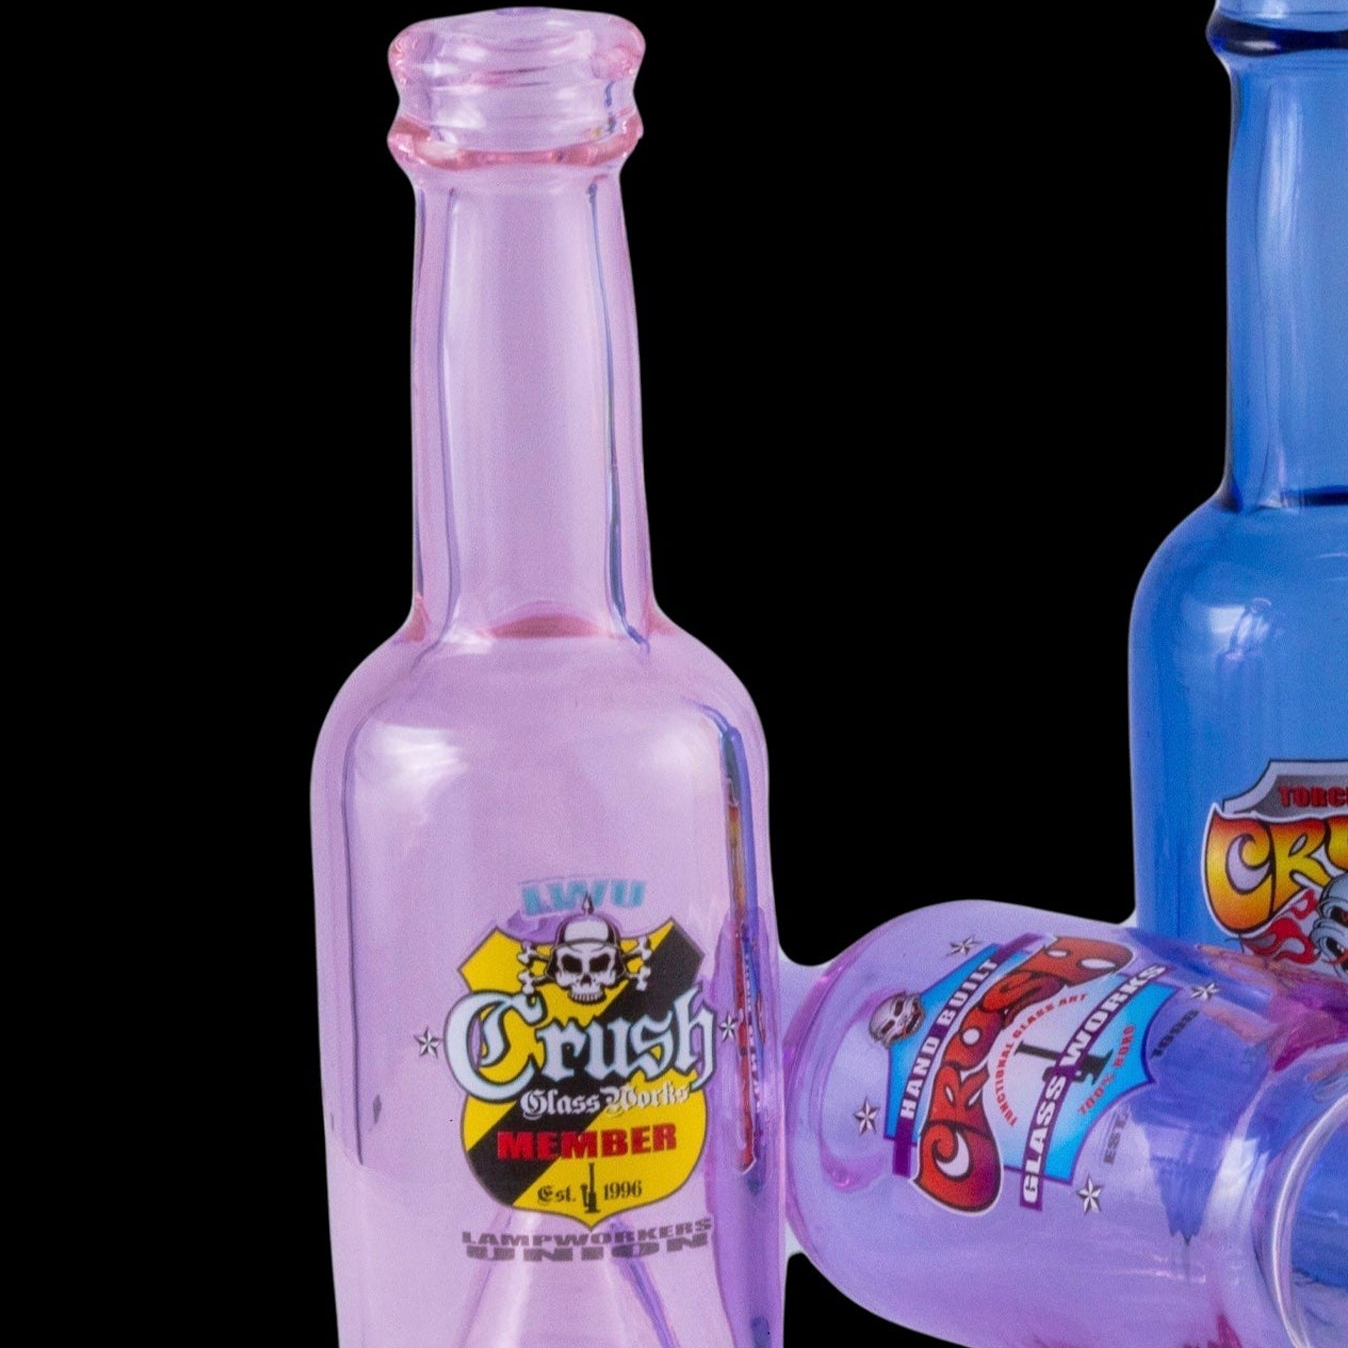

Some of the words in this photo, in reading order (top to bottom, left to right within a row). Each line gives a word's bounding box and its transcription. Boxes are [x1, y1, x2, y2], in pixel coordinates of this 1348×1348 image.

[443, 981, 718, 1103] Crush
[899, 1035, 939, 1120] HAND
[935, 957, 1001, 1034] BUILT
[912, 935, 1134, 1216] CRUSH
[519, 1089, 601, 1120] Glass
[600, 1081, 690, 1118] Works
[1022, 1073, 1066, 1204] GLASS
[1058, 963, 1167, 1069] WORKS
[497, 1122, 678, 1162] MEMBER
[461, 1217, 713, 1247] LAMPWORKERS
[537, 1180, 577, 1206] Est.
[602, 1180, 643, 1201] 1996
